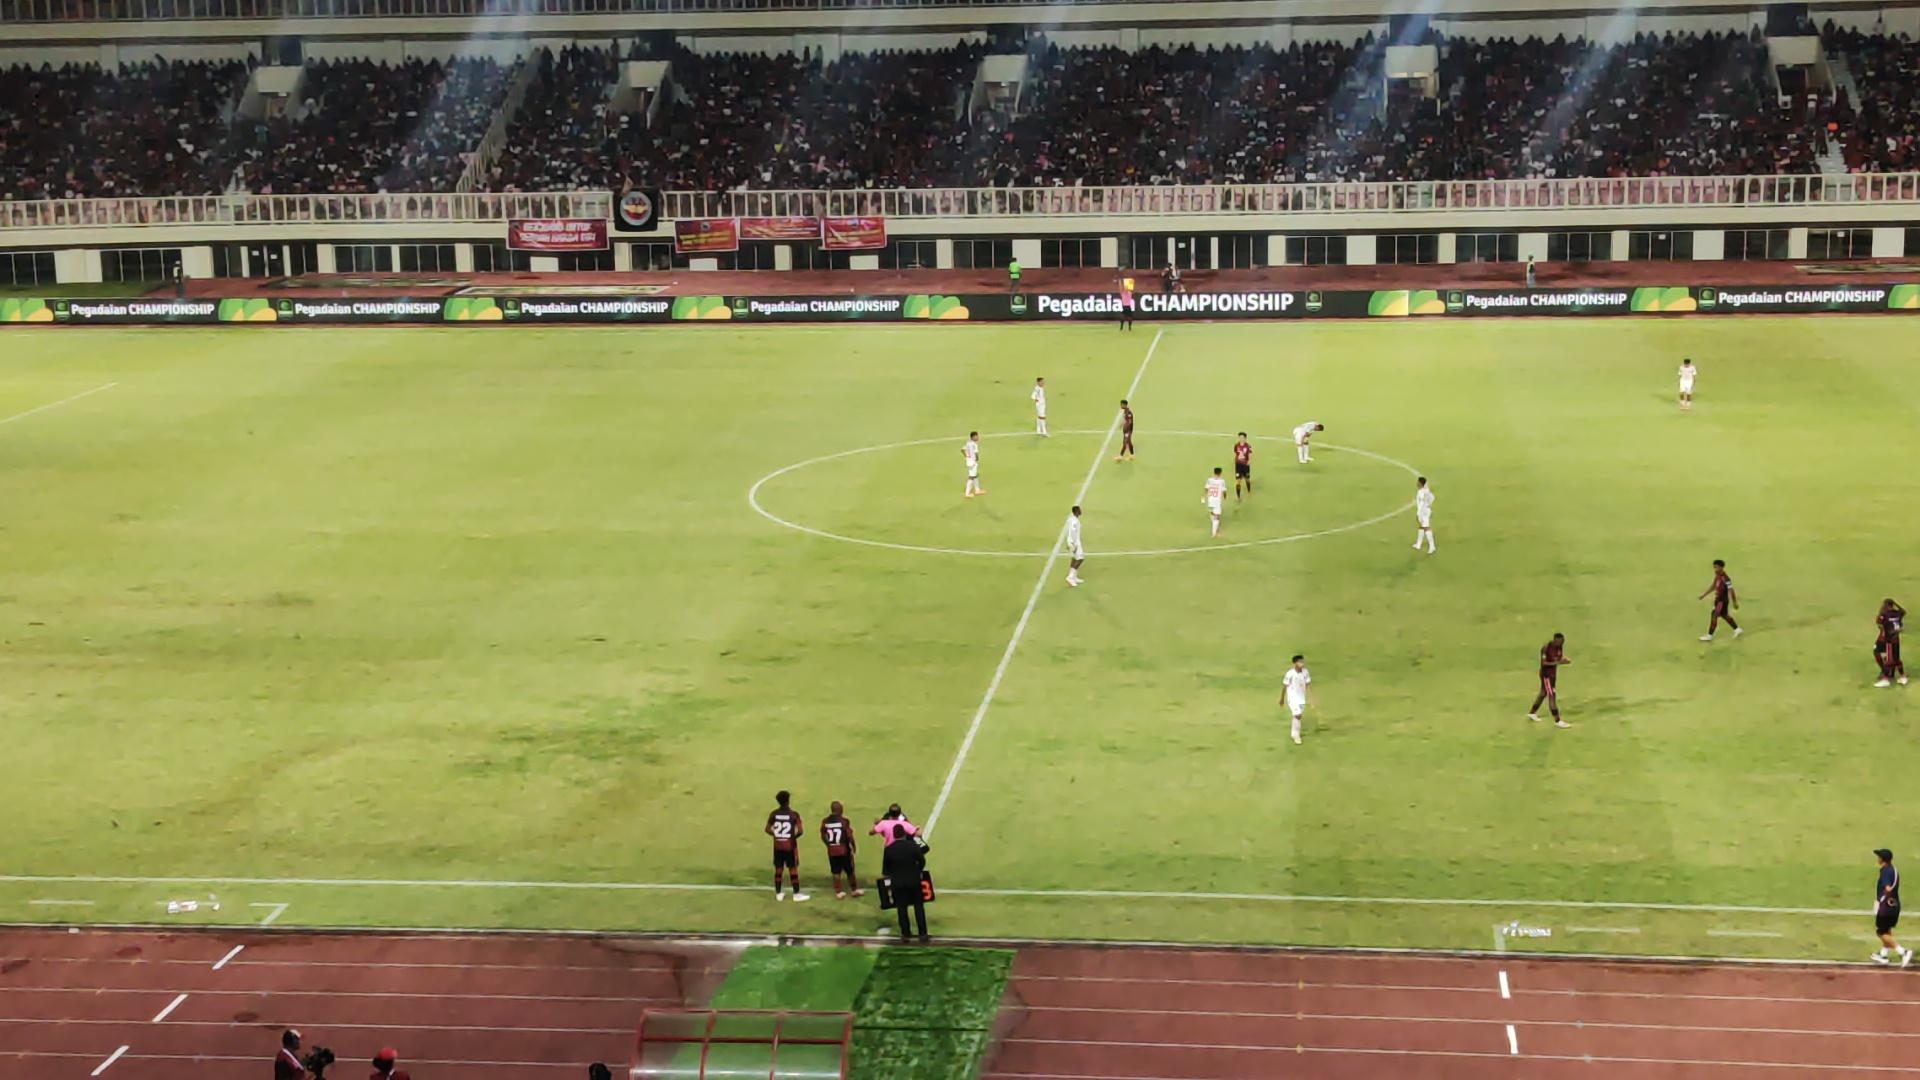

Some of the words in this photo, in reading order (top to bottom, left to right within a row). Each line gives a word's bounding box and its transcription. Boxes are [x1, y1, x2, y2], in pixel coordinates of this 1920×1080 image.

[1140, 293, 1294, 312] CHAMPIONSHIP
[1466, 294, 1527, 309] Pegadaian
[1530, 293, 1627, 306] CHAMPIONSHIP
[1718, 292, 1782, 306] Pegadaian
[1785, 290, 1884, 304] CHAMPIONSHIP
[71, 304, 126, 318] Pegadaian
[128, 304, 215, 315] CHAMPIONSHIP
[295, 303, 351, 317] Pegadaian
[353, 302, 440, 314] CHAMPIONSHIP
[521, 302, 578, 316] Pegadaian
[580, 301, 668, 313] CHAMPIONSHIP
[751, 301, 808, 315] Pegadaian
[811, 300, 899, 312] CHAMPIONSHIP
[773, 821, 791, 838] 22
